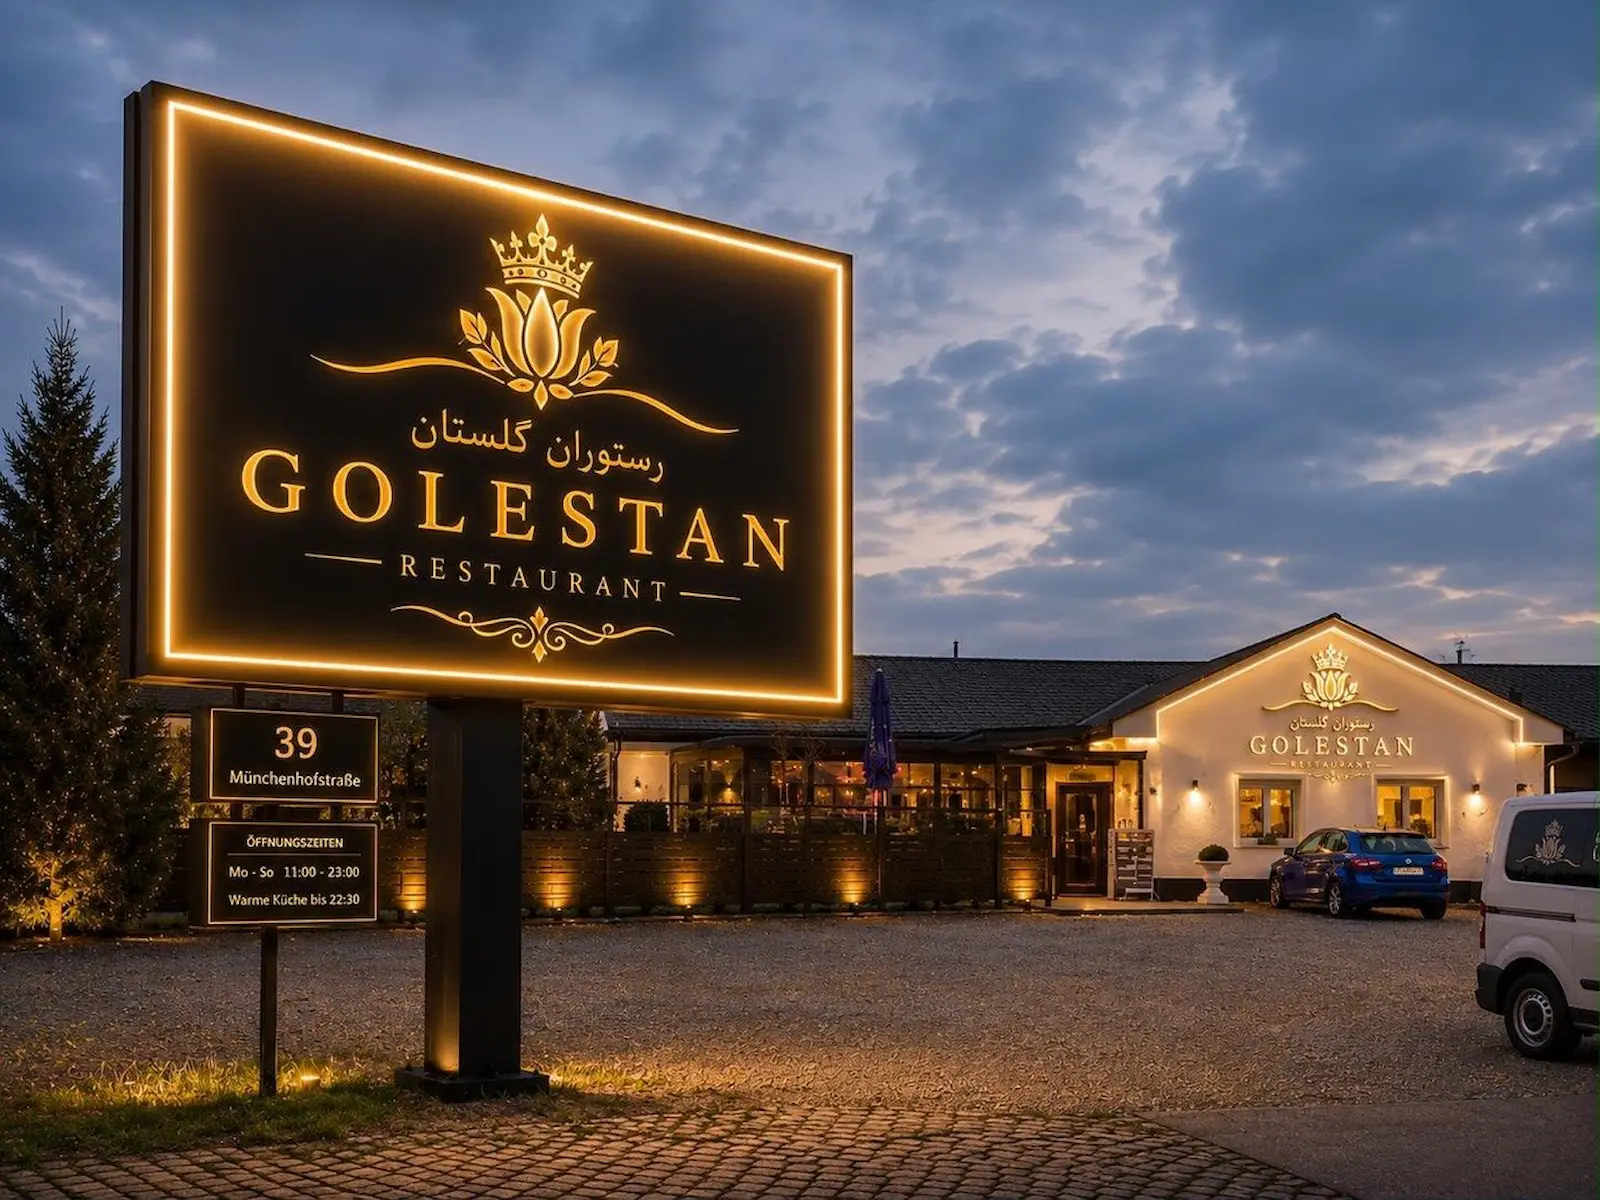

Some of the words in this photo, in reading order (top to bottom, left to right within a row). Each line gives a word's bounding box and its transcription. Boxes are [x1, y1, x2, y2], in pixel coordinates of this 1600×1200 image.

[411, 408, 533, 453] گلستان
[546, 430, 665, 483] رستوران
[241, 449, 790, 572] GOLESTAN
[400, 553, 667, 602] RESTAURANT
[274, 726, 318, 759] 39
[1250, 735, 1414, 756] GOLESTAN
[229, 770, 361, 788] Münchenhofstraße
[246, 835, 344, 849] ÖFFNUNGSZEITEN
[229, 866, 249, 878] Mo
[259, 866, 275, 878] So
[284, 866, 317, 878] 11:00
[327, 866, 360, 878] 23:00
[228, 894, 270, 906] Warme
[272, 893, 308, 906] Küche
[310, 893, 327, 906] bis
[329, 894, 360, 905] 22:30
